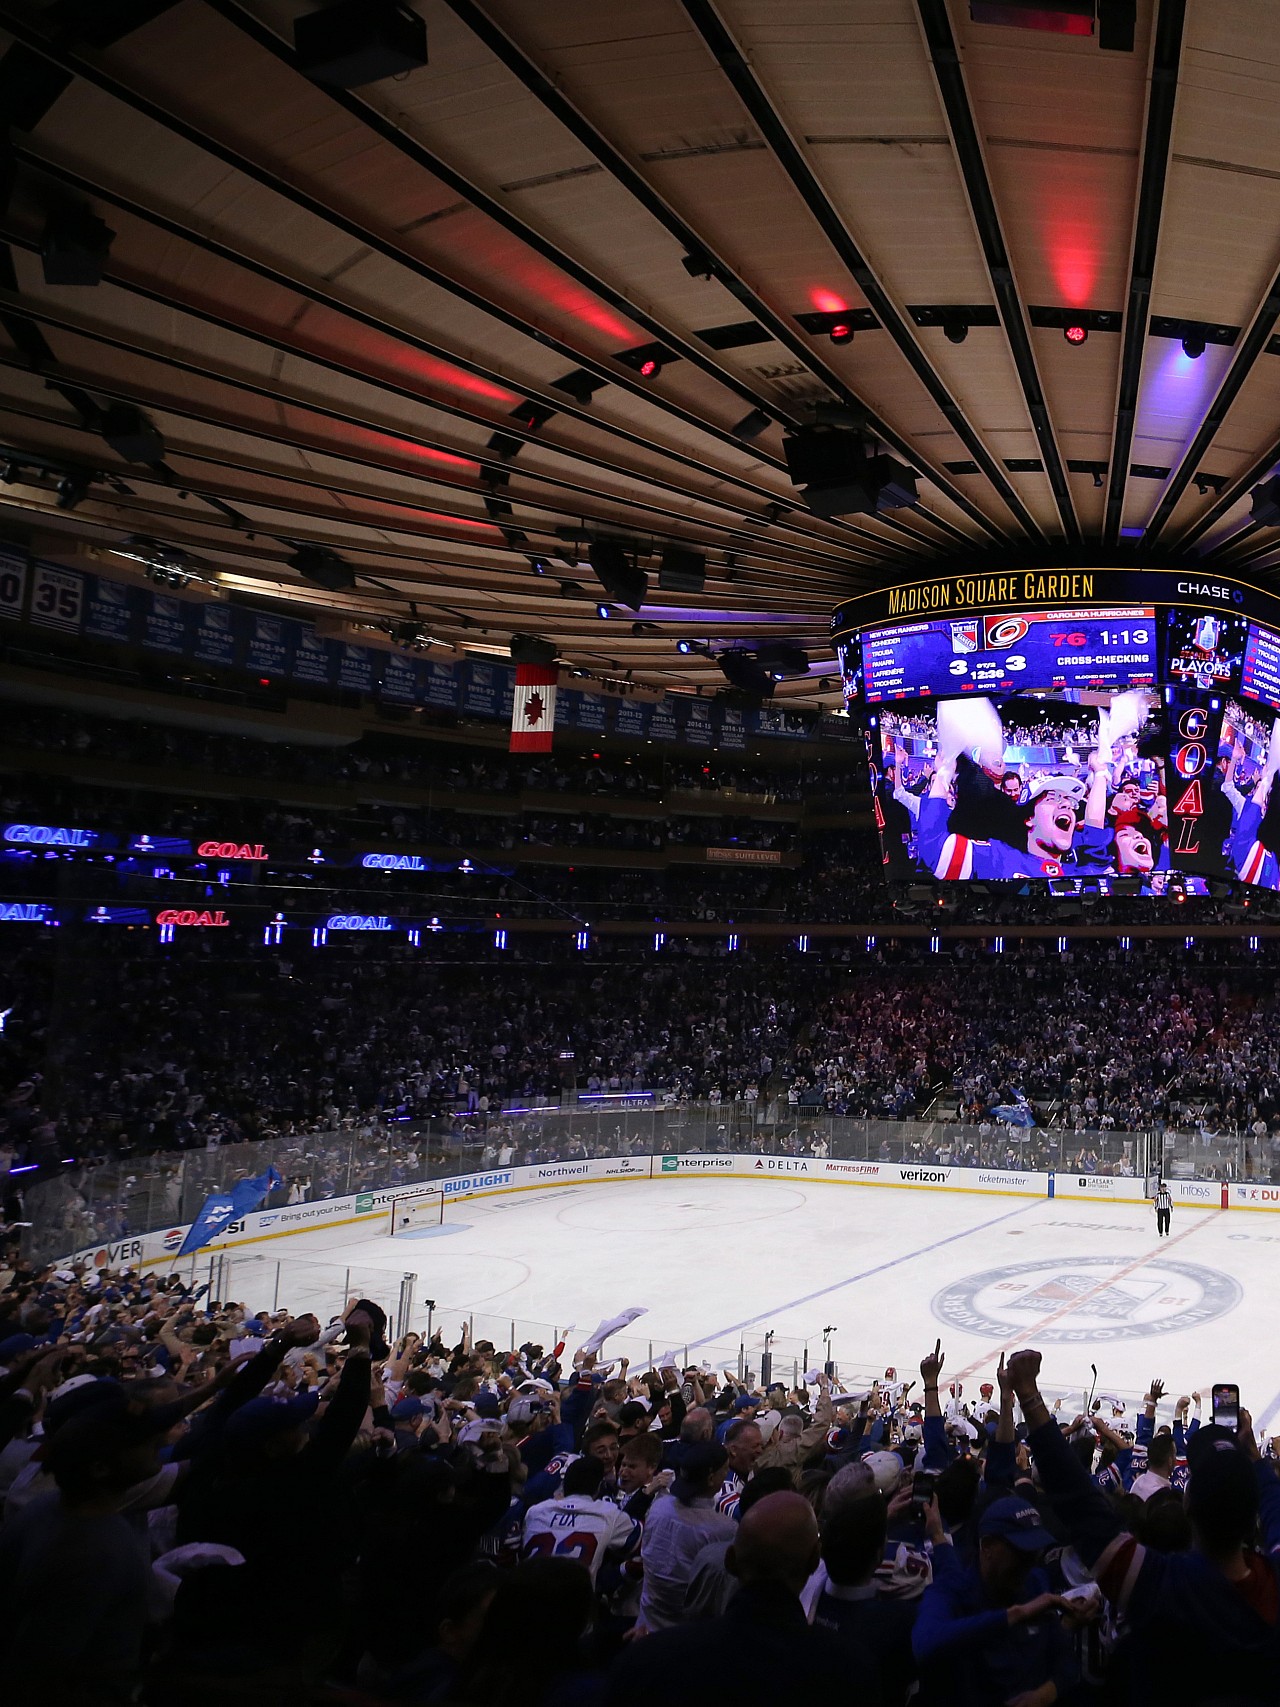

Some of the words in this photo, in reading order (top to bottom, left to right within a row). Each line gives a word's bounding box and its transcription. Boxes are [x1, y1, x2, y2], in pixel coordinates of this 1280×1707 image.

[889, 584, 949, 614] MADISON
[956, 579, 1018, 605] SQUARE
[1024, 573, 1094, 599] GARDEN
[1177, 582, 1230, 600] CHASE
[36, 583, 79, 618] 35
[1046, 611, 1090, 619] CAROLINA
[1090, 610, 1145, 618] HURRICANES
[897, 624, 929, 634] RANGERS
[871, 637, 901, 648] SCHNEIDER
[1050, 632, 1087, 646] 76
[1100, 629, 1149, 645] 1:13
[872, 649, 894, 657] TROUBA
[1057, 654, 1150, 666] CROSS-CHECKING
[872, 659, 895, 668] PANARIN
[949, 660, 968, 676] 3
[1005, 655, 1027, 671] 3
[1170, 657, 1231, 677] PLAYOFFS
[970, 669, 1005, 680] 12:36
[874, 679, 903, 688] TROCHECK
[618, 709, 643, 719] 2011-12
[1173, 707, 1209, 854] GOAL
[3, 824, 90, 847] GOAL
[197, 841, 269, 860] GOAL
[734, 852, 755, 861] SUITE
[756, 853, 778, 862] LEVEL
[362, 853, 425, 870] GOAL
[156, 910, 229, 926] GOAL
[327, 915, 392, 930] GOAL
[620, 1099, 650, 1107] ULTRA
[664, 1156, 733, 1169] enterprise
[768, 1159, 809, 1172] DELTA
[538, 1165, 589, 1179] Northwell
[900, 1168, 946, 1183] verizon
[444, 1179, 471, 1193] BUD
[472, 1173, 512, 1189] LIGHT
[977, 1174, 1028, 1186] ticketmaster
[1180, 1184, 1211, 1198] Infosys
[281, 1213, 302, 1222] Bring
[316, 1208, 334, 1218] your
[1152, 1308, 1214, 1331] NEW
[1039, 1327, 1139, 1342] YORK
[550, 1513, 578, 1528] FOX
